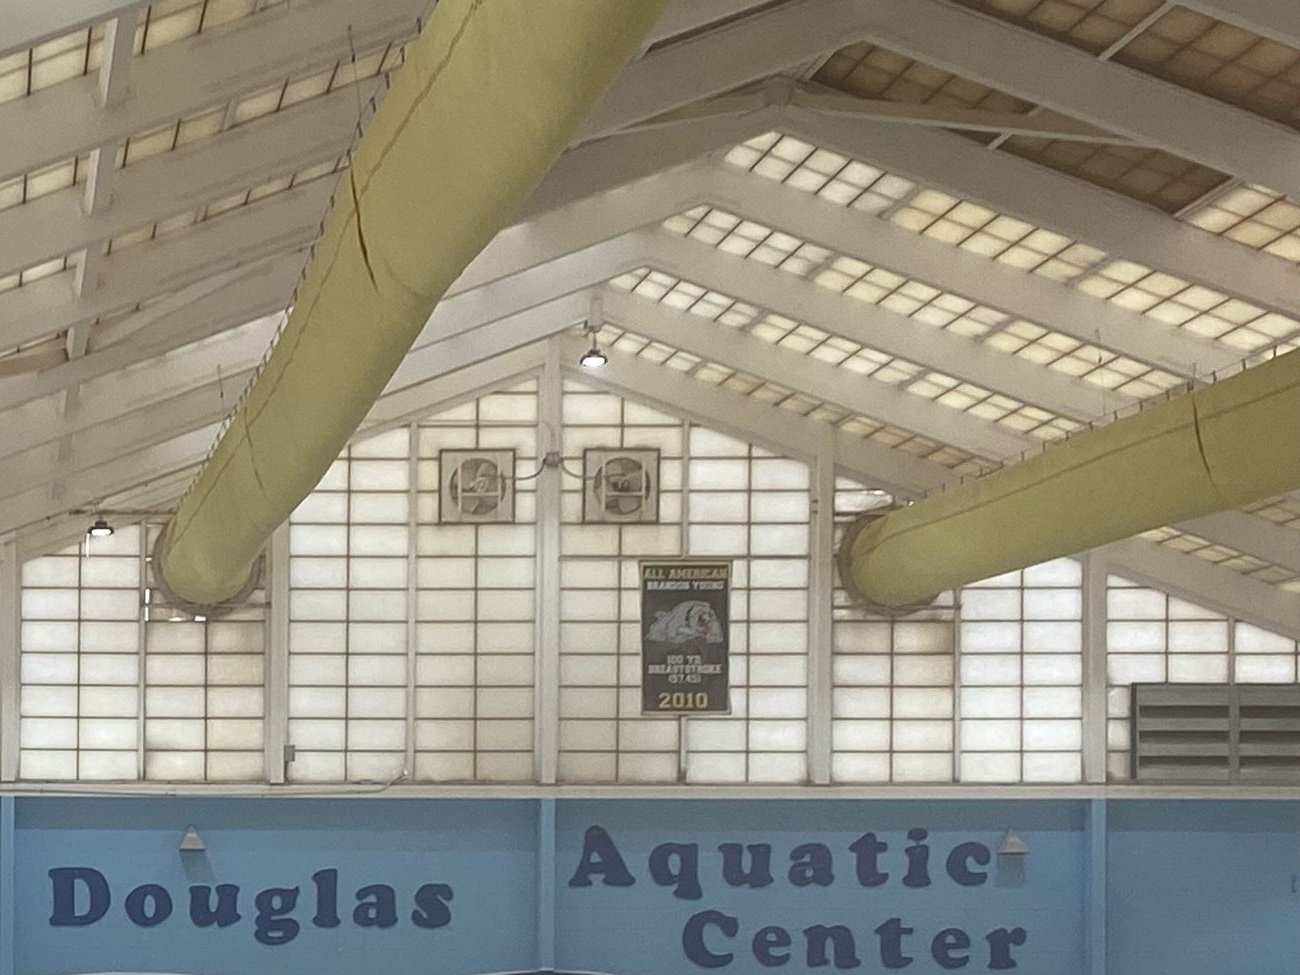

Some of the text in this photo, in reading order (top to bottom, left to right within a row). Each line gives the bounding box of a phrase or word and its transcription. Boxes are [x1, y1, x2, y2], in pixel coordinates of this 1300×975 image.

[644, 567, 728, 580] ALL AMERICAN
[648, 664, 722, 674] BREASTSTROKE
[658, 692, 709, 709] 2010
[568, 825, 991, 900] Aquatic
[48, 867, 454, 945] Douglas
[682, 910, 1027, 969] Center
